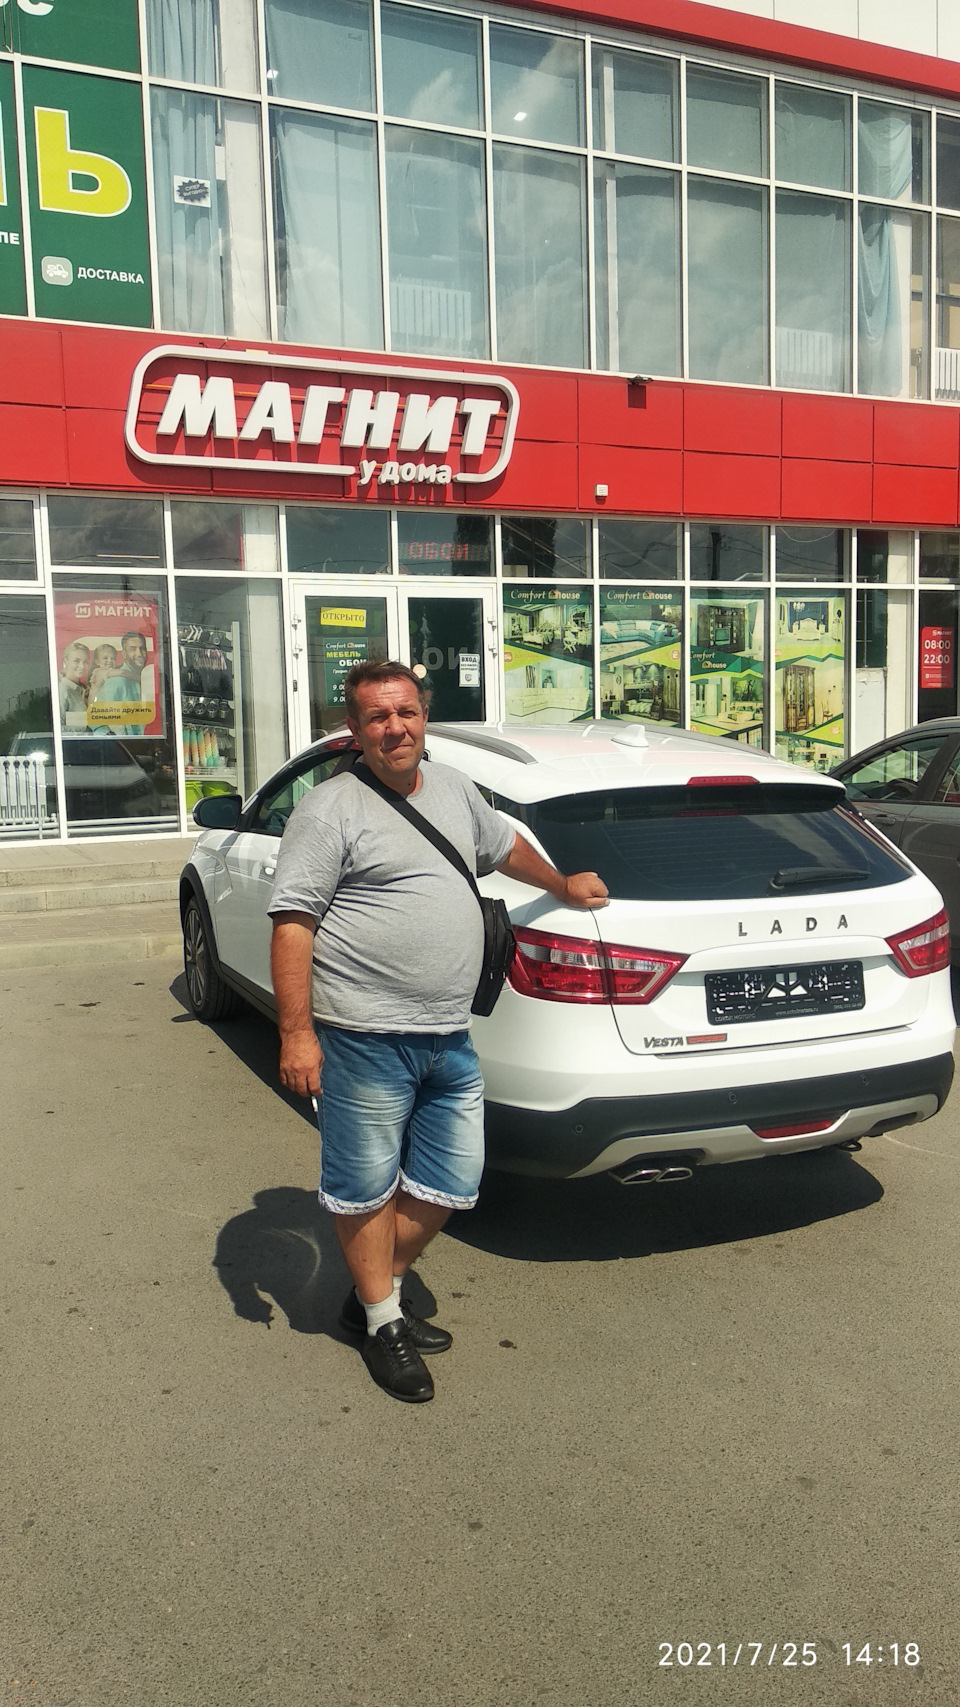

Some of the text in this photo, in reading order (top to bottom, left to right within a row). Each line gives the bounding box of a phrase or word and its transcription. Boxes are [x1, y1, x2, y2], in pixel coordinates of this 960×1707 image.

[0, 98, 132, 218] Ь
[77, 266, 144, 285] ДОСТАВКА
[156, 373, 501, 456] МАГНИТ
[379, 460, 452, 485] дома
[408, 541, 469, 560] ОБОИ
[511, 588, 546, 604] Comfort
[607, 588, 640, 605] Comfort
[94, 605, 151, 618] МАГНИТ
[322, 611, 365, 623] ОТКРЫТО
[924, 640, 951, 650] 08:00
[923, 654, 950, 664] 22:00
[91, 706, 152, 715] Давайте дружить
[737, 914, 849, 937] LADA
